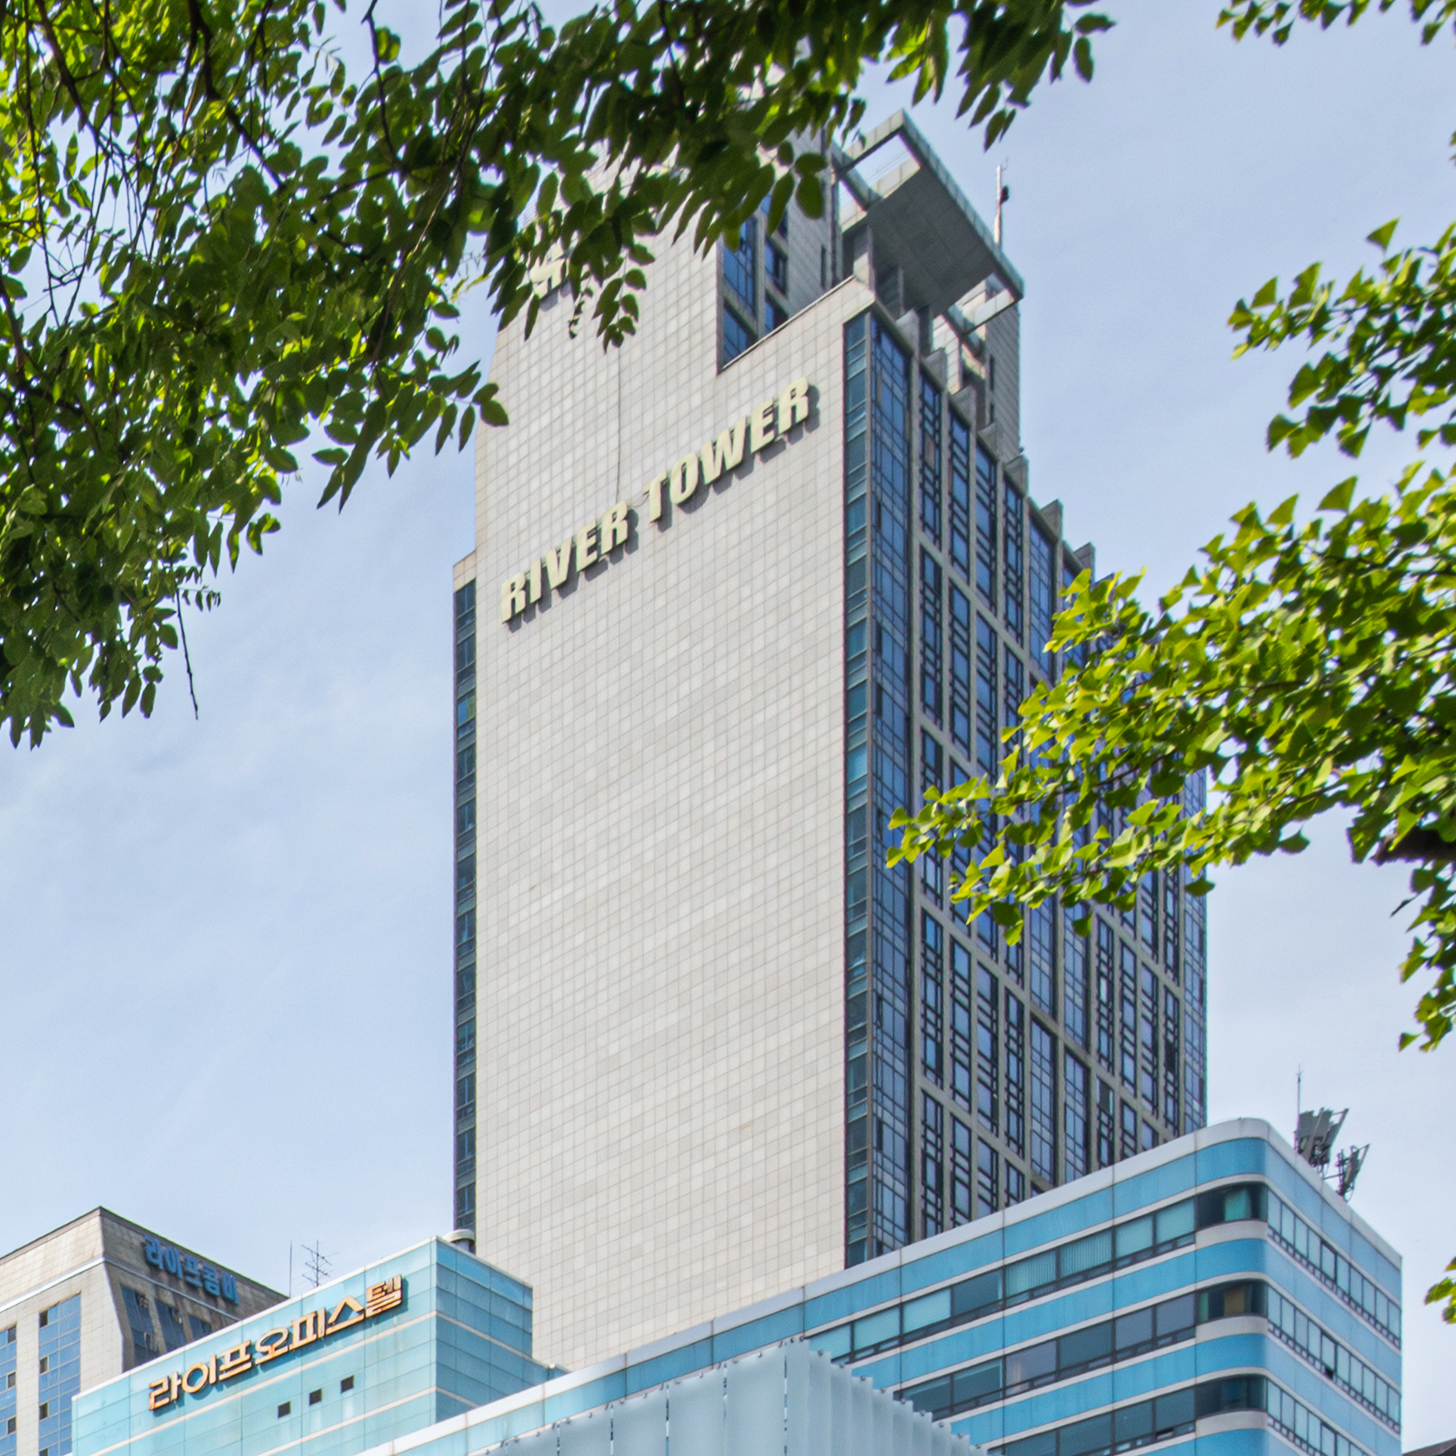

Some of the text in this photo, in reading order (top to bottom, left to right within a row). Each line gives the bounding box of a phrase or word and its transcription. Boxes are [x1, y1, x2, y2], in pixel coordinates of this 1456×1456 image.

[500, 376, 811, 624] RIVER TOWER
[148, 1274, 404, 1412] 라이프오피스텔
